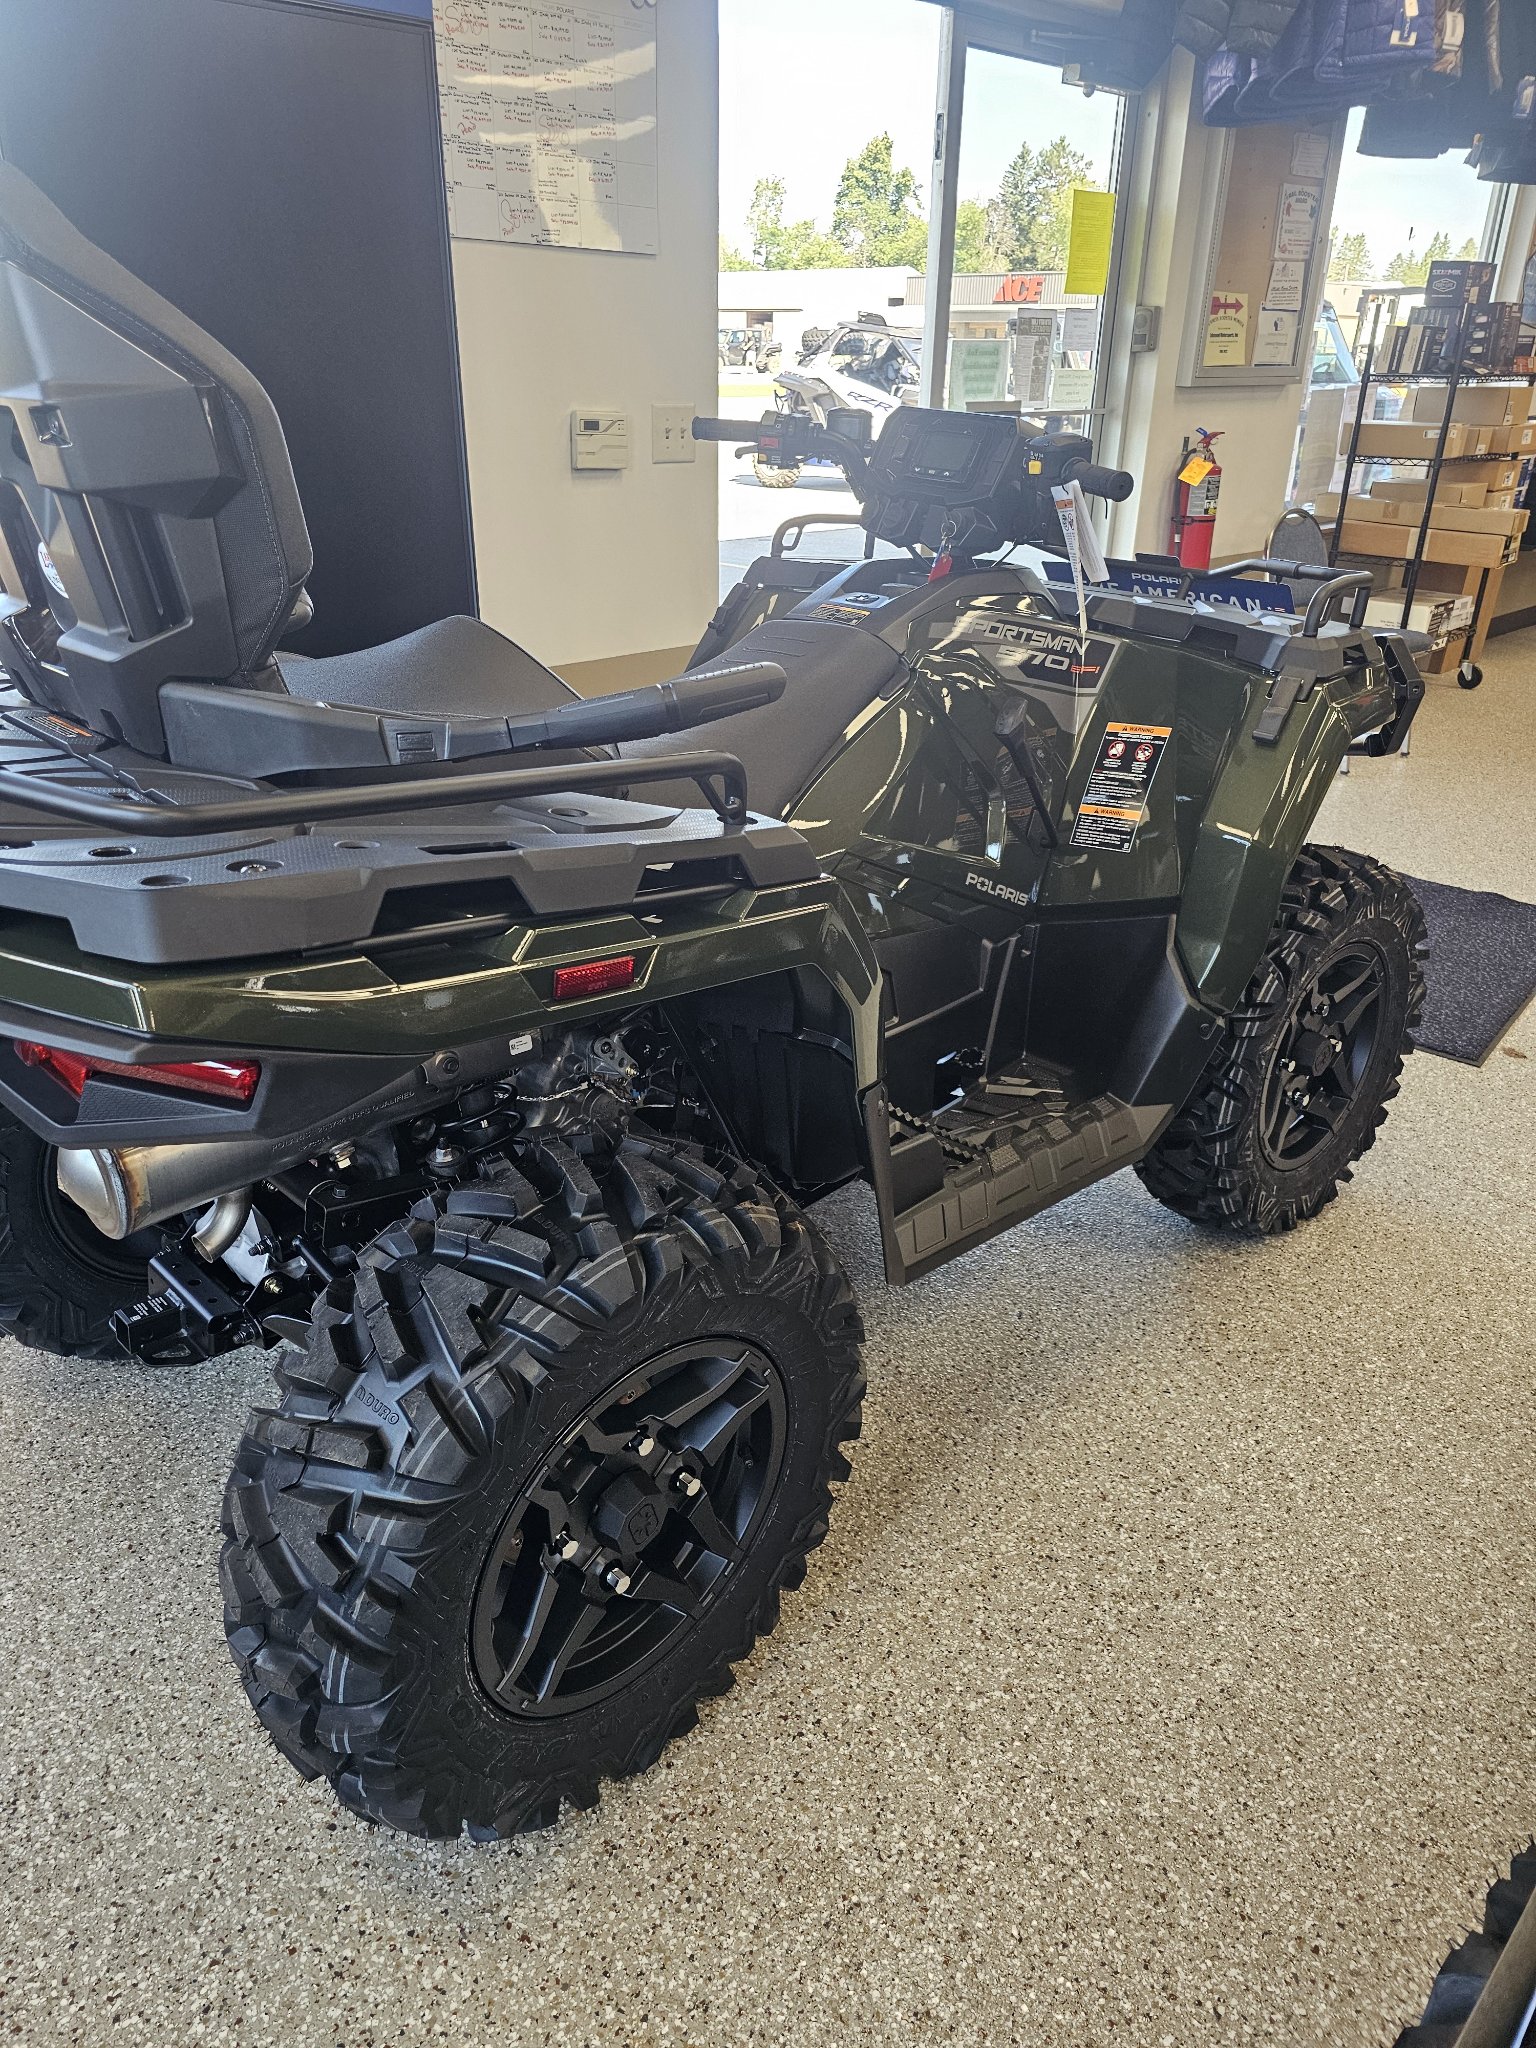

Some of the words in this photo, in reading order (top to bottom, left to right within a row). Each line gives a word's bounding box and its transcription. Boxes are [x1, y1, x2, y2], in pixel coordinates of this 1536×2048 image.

[993, 275, 1045, 304] ACE
[1132, 572, 1182, 585] POLARI
[1132, 584, 1261, 613] AMERICAN
[952, 616, 1091, 656] SPORTSMAN
[996, 644, 1070, 671] 570
[1100, 809, 1125, 817] WARNING
[965, 872, 1029, 907] POLARIS
[365, 1392, 400, 1425] DURO
